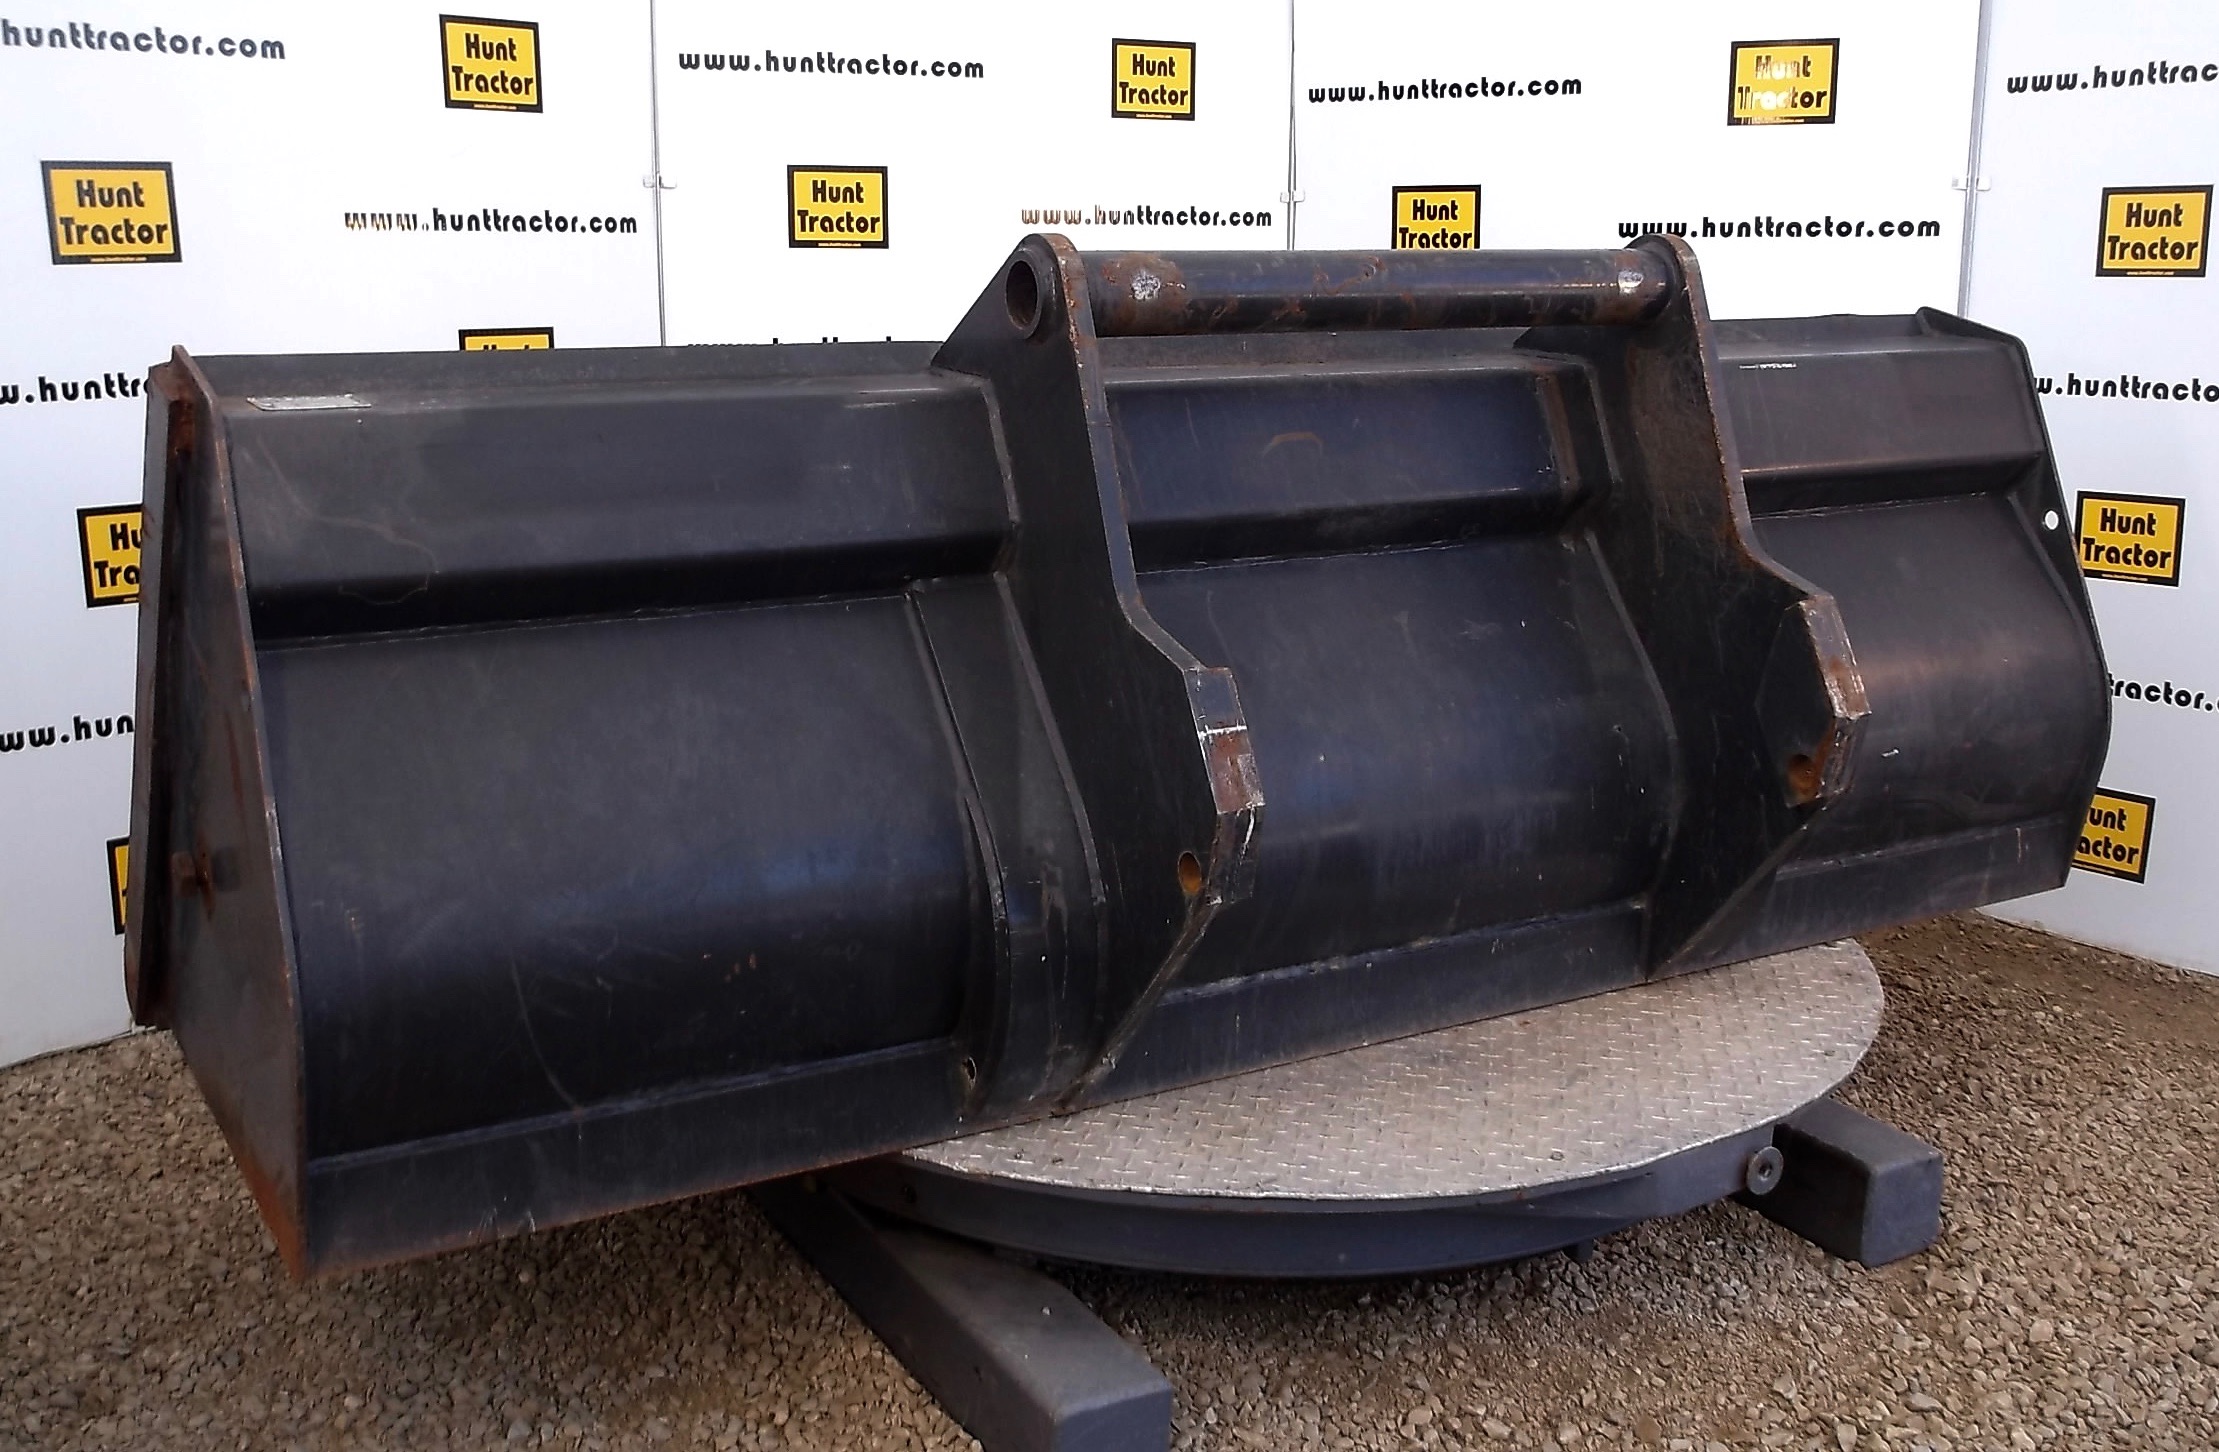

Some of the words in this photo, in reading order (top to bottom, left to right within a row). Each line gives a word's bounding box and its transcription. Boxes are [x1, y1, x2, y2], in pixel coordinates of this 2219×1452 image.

[1, 18, 286, 59] hunttractor.com
[465, 32, 517, 62] Hunt
[678, 50, 984, 78] www.hunttractor.com
[1132, 53, 1176, 77] Hunt
[2007, 60, 2219, 94] www.hunttrac
[452, 65, 533, 95] Tractor
[1119, 81, 1188, 105] Tractor
[1308, 76, 1581, 103] www.hunttractor.com
[76, 179, 145, 208] Hunt
[812, 179, 864, 204] Hunt
[344, 207, 638, 234] www.hunttractor.com
[797, 209, 880, 233] Tractor
[1021, 204, 1272, 227] www.hunttractor.com
[1412, 198, 1458, 221] Hunt
[2125, 202, 2183, 228] Hunt
[59, 216, 168, 245] Tractor
[1399, 226, 1472, 248] Tractor
[1618, 215, 1941, 239] www.hunttractor.com
[2107, 235, 2199, 261] Tractor
[2100, 507, 2157, 537] Hunt
[2082, 537, 2172, 569] Tractor
